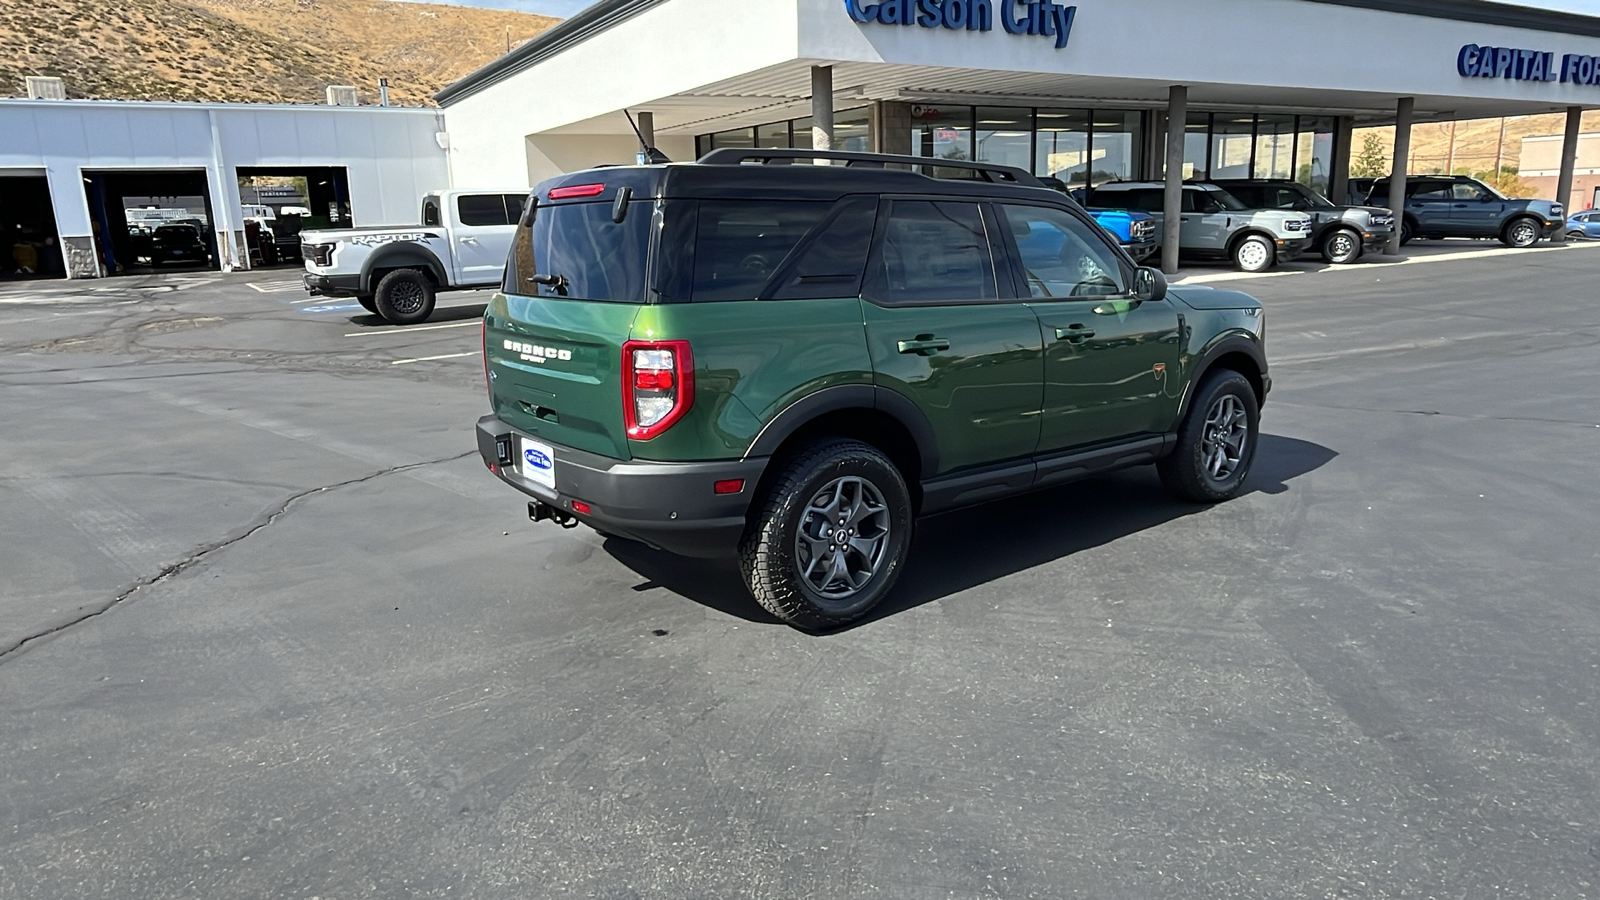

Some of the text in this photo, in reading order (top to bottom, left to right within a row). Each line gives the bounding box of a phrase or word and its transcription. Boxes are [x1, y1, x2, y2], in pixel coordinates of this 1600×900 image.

[846, 0, 1077, 48] Carson City
[1457, 43, 1557, 82] CAPITAL
[352, 233, 431, 247] RAPTOR
[503, 339, 572, 361] BRONCO
